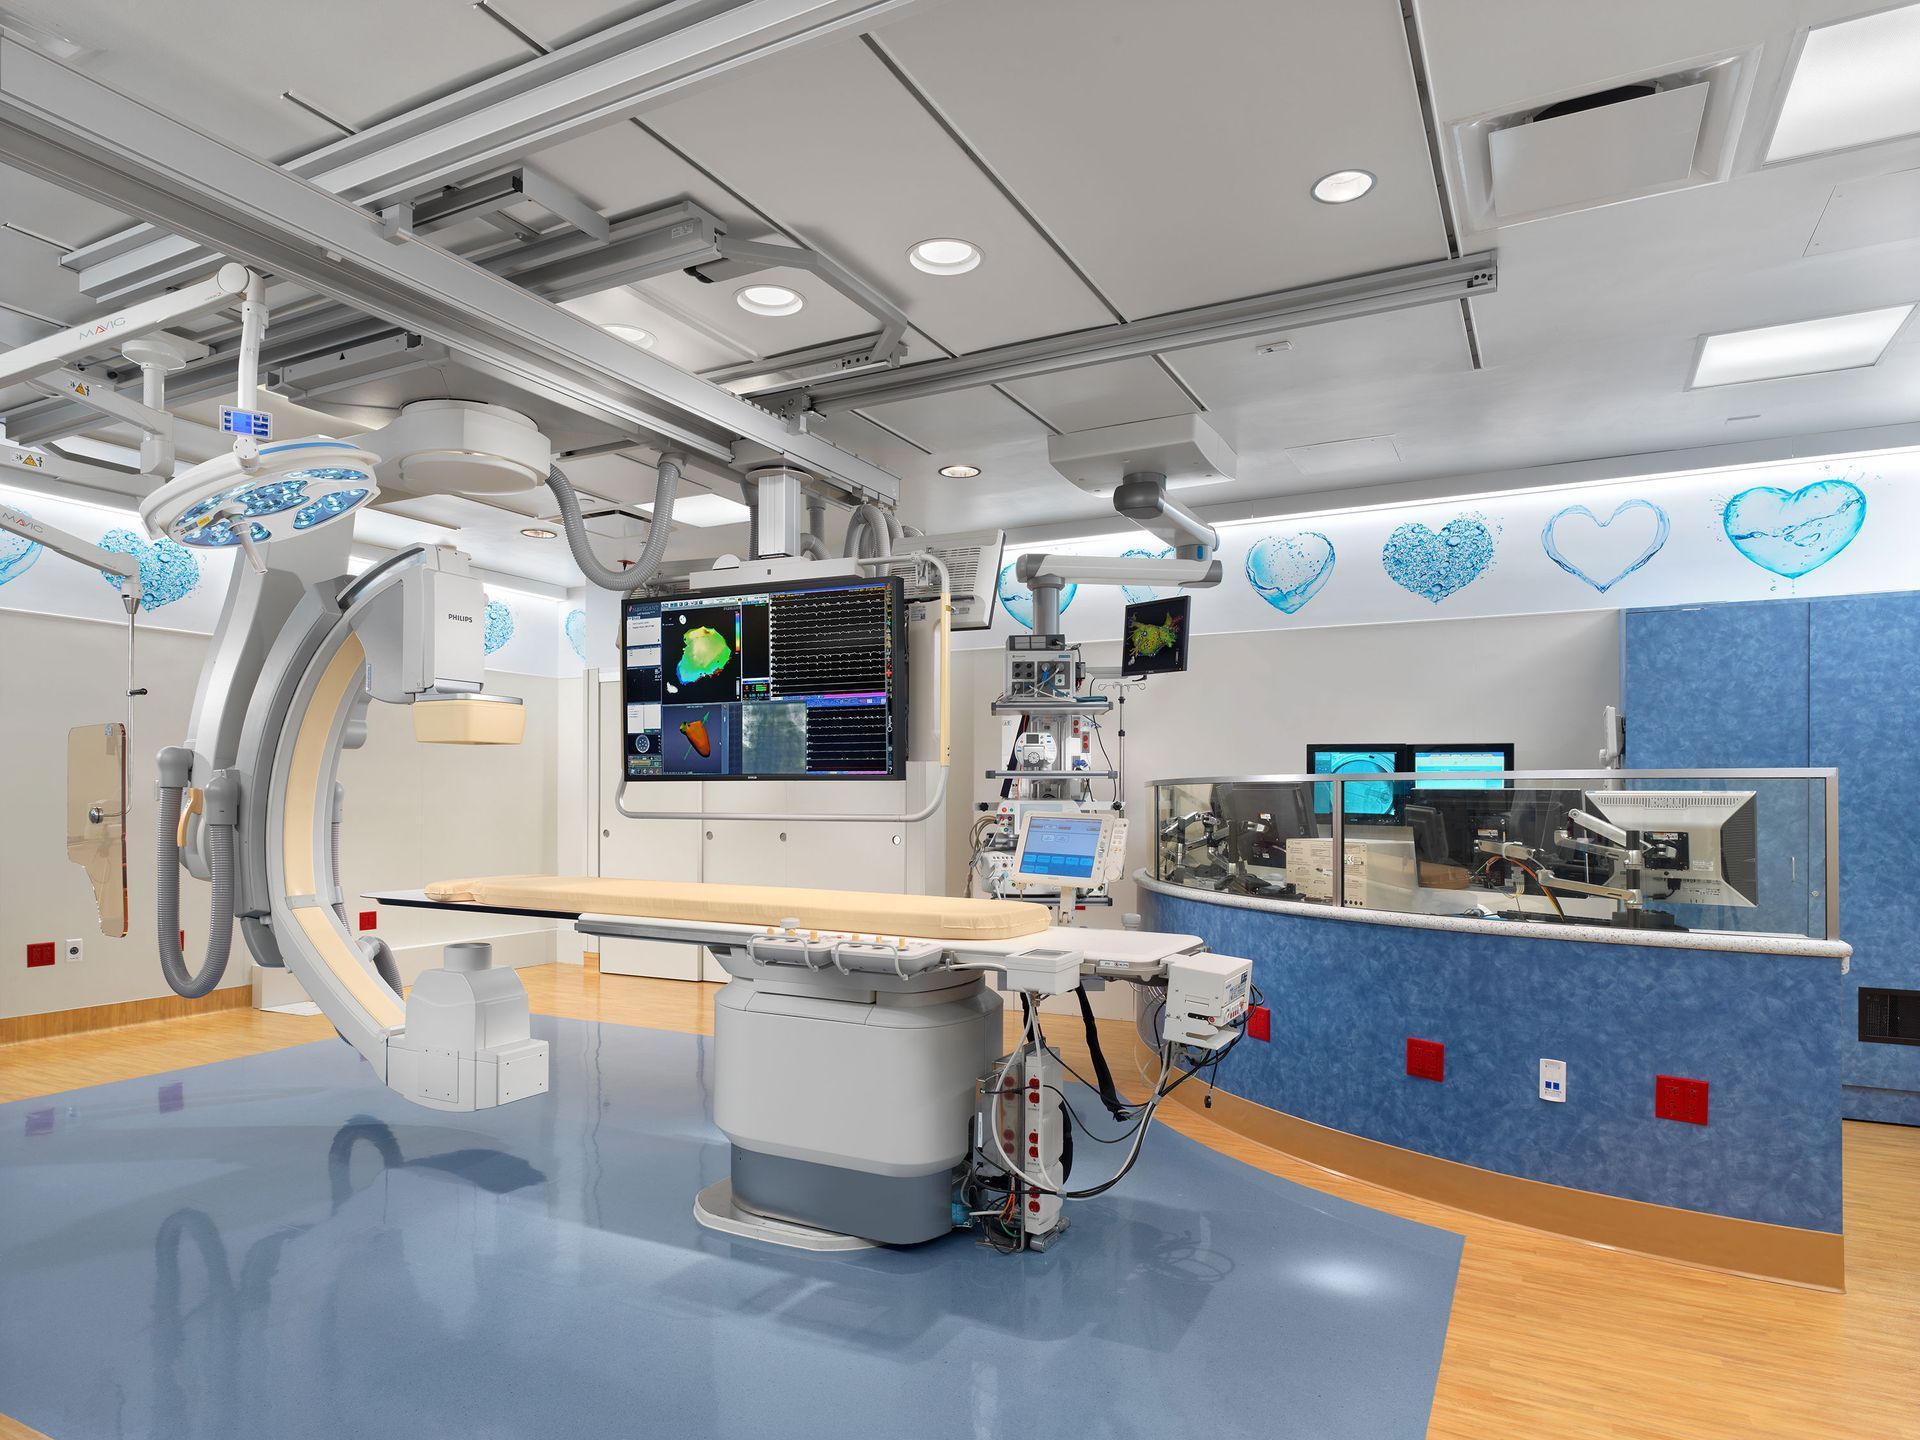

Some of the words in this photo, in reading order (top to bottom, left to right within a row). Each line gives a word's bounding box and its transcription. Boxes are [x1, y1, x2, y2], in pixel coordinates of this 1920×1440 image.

[79, 317, 126, 340] MAVIG
[2, 512, 43, 533] MAVIG
[448, 613, 473, 623] PHILIPS
